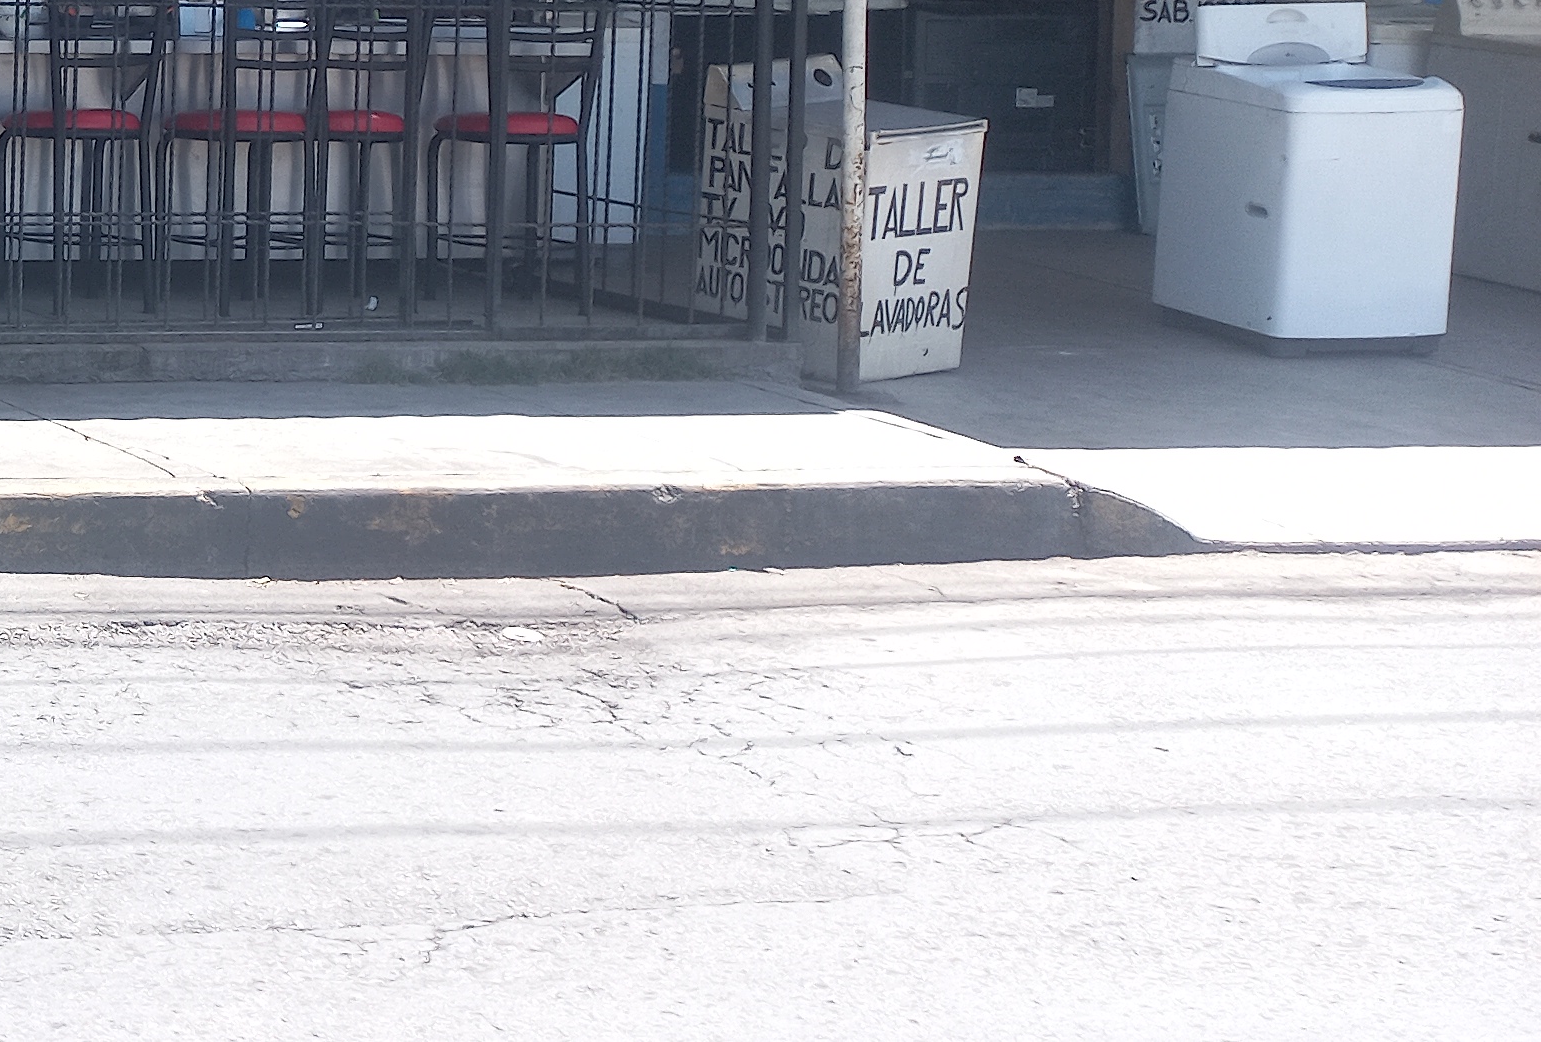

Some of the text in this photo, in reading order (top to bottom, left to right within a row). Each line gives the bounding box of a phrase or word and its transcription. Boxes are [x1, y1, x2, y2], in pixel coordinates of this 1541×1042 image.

[868, 177, 970, 241] TALLER
[893, 247, 932, 289] DE
[859, 285, 970, 339] LAVADORAS
